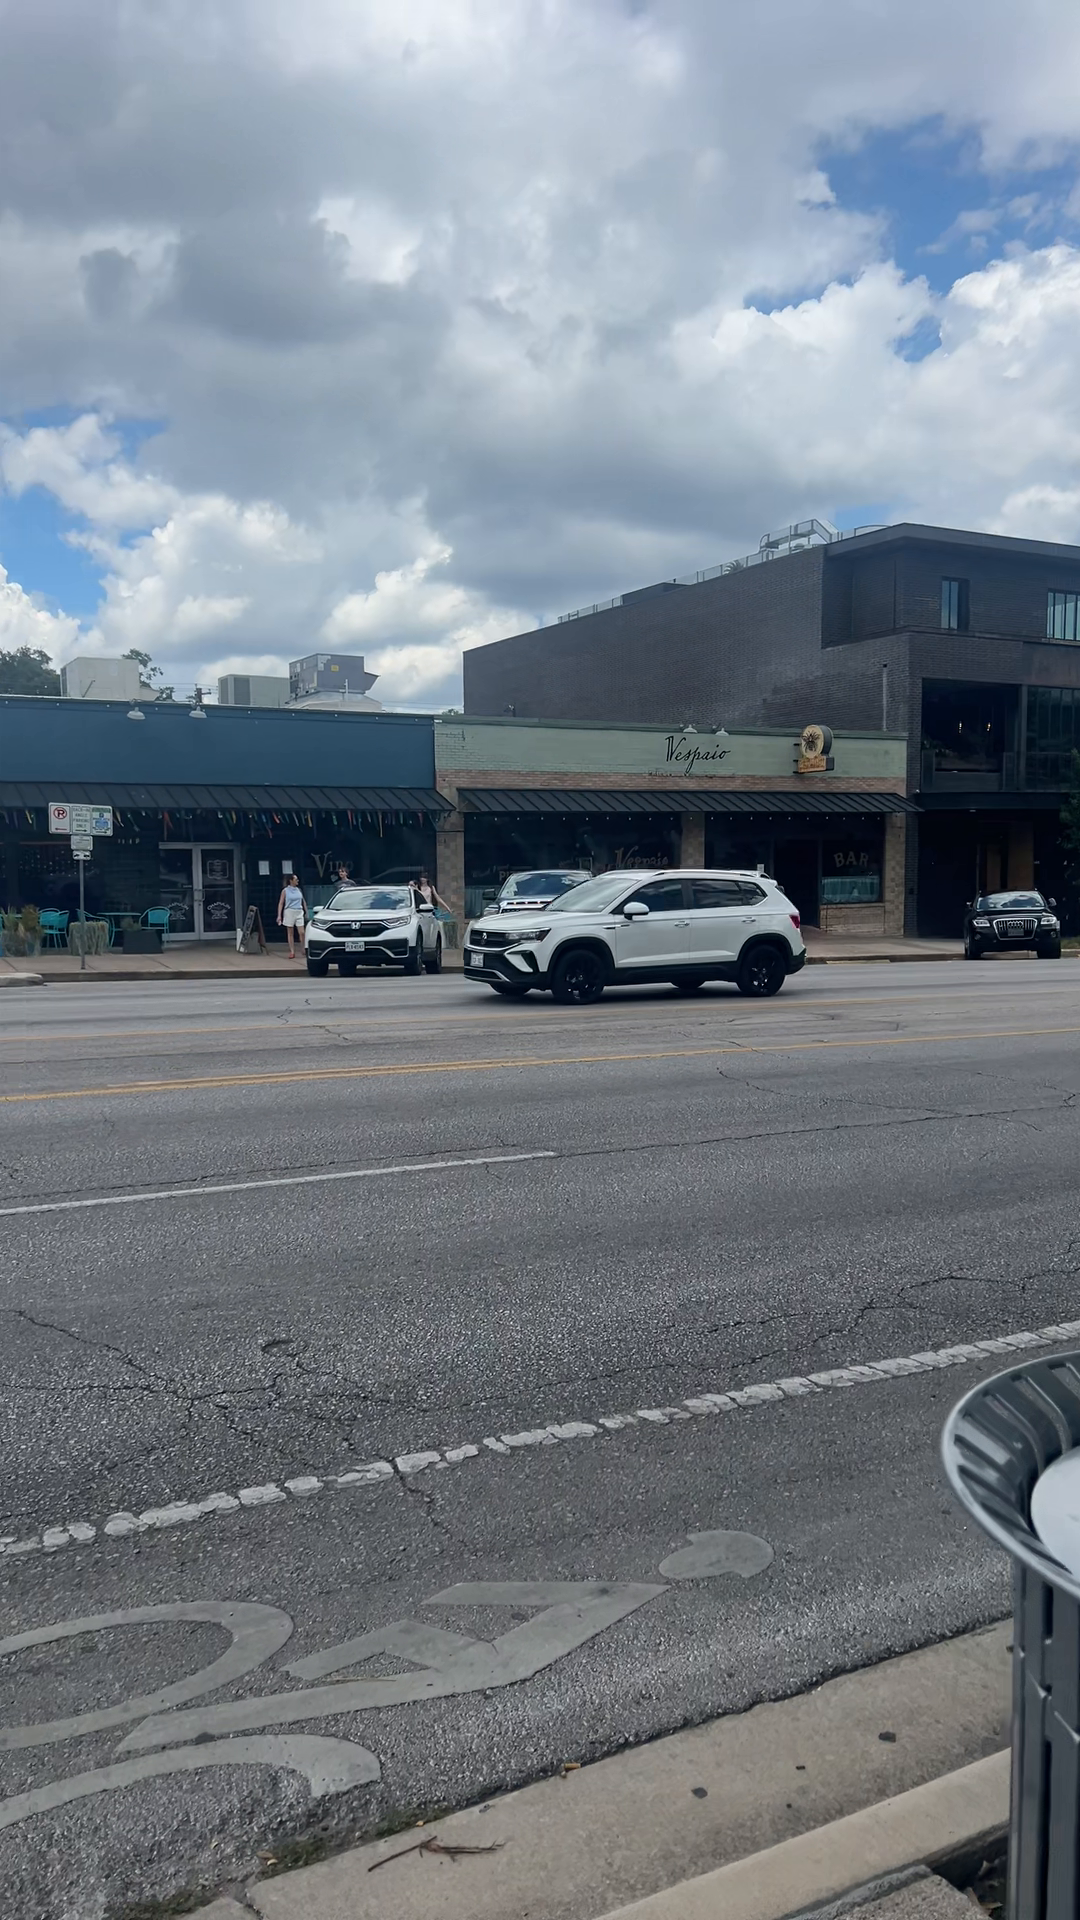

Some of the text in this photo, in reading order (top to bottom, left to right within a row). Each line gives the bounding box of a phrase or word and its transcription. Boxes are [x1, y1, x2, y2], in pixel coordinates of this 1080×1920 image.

[665, 735, 731, 774] Vespaio
[310, 851, 354, 878] Vino
[833, 851, 869, 868] BAR
